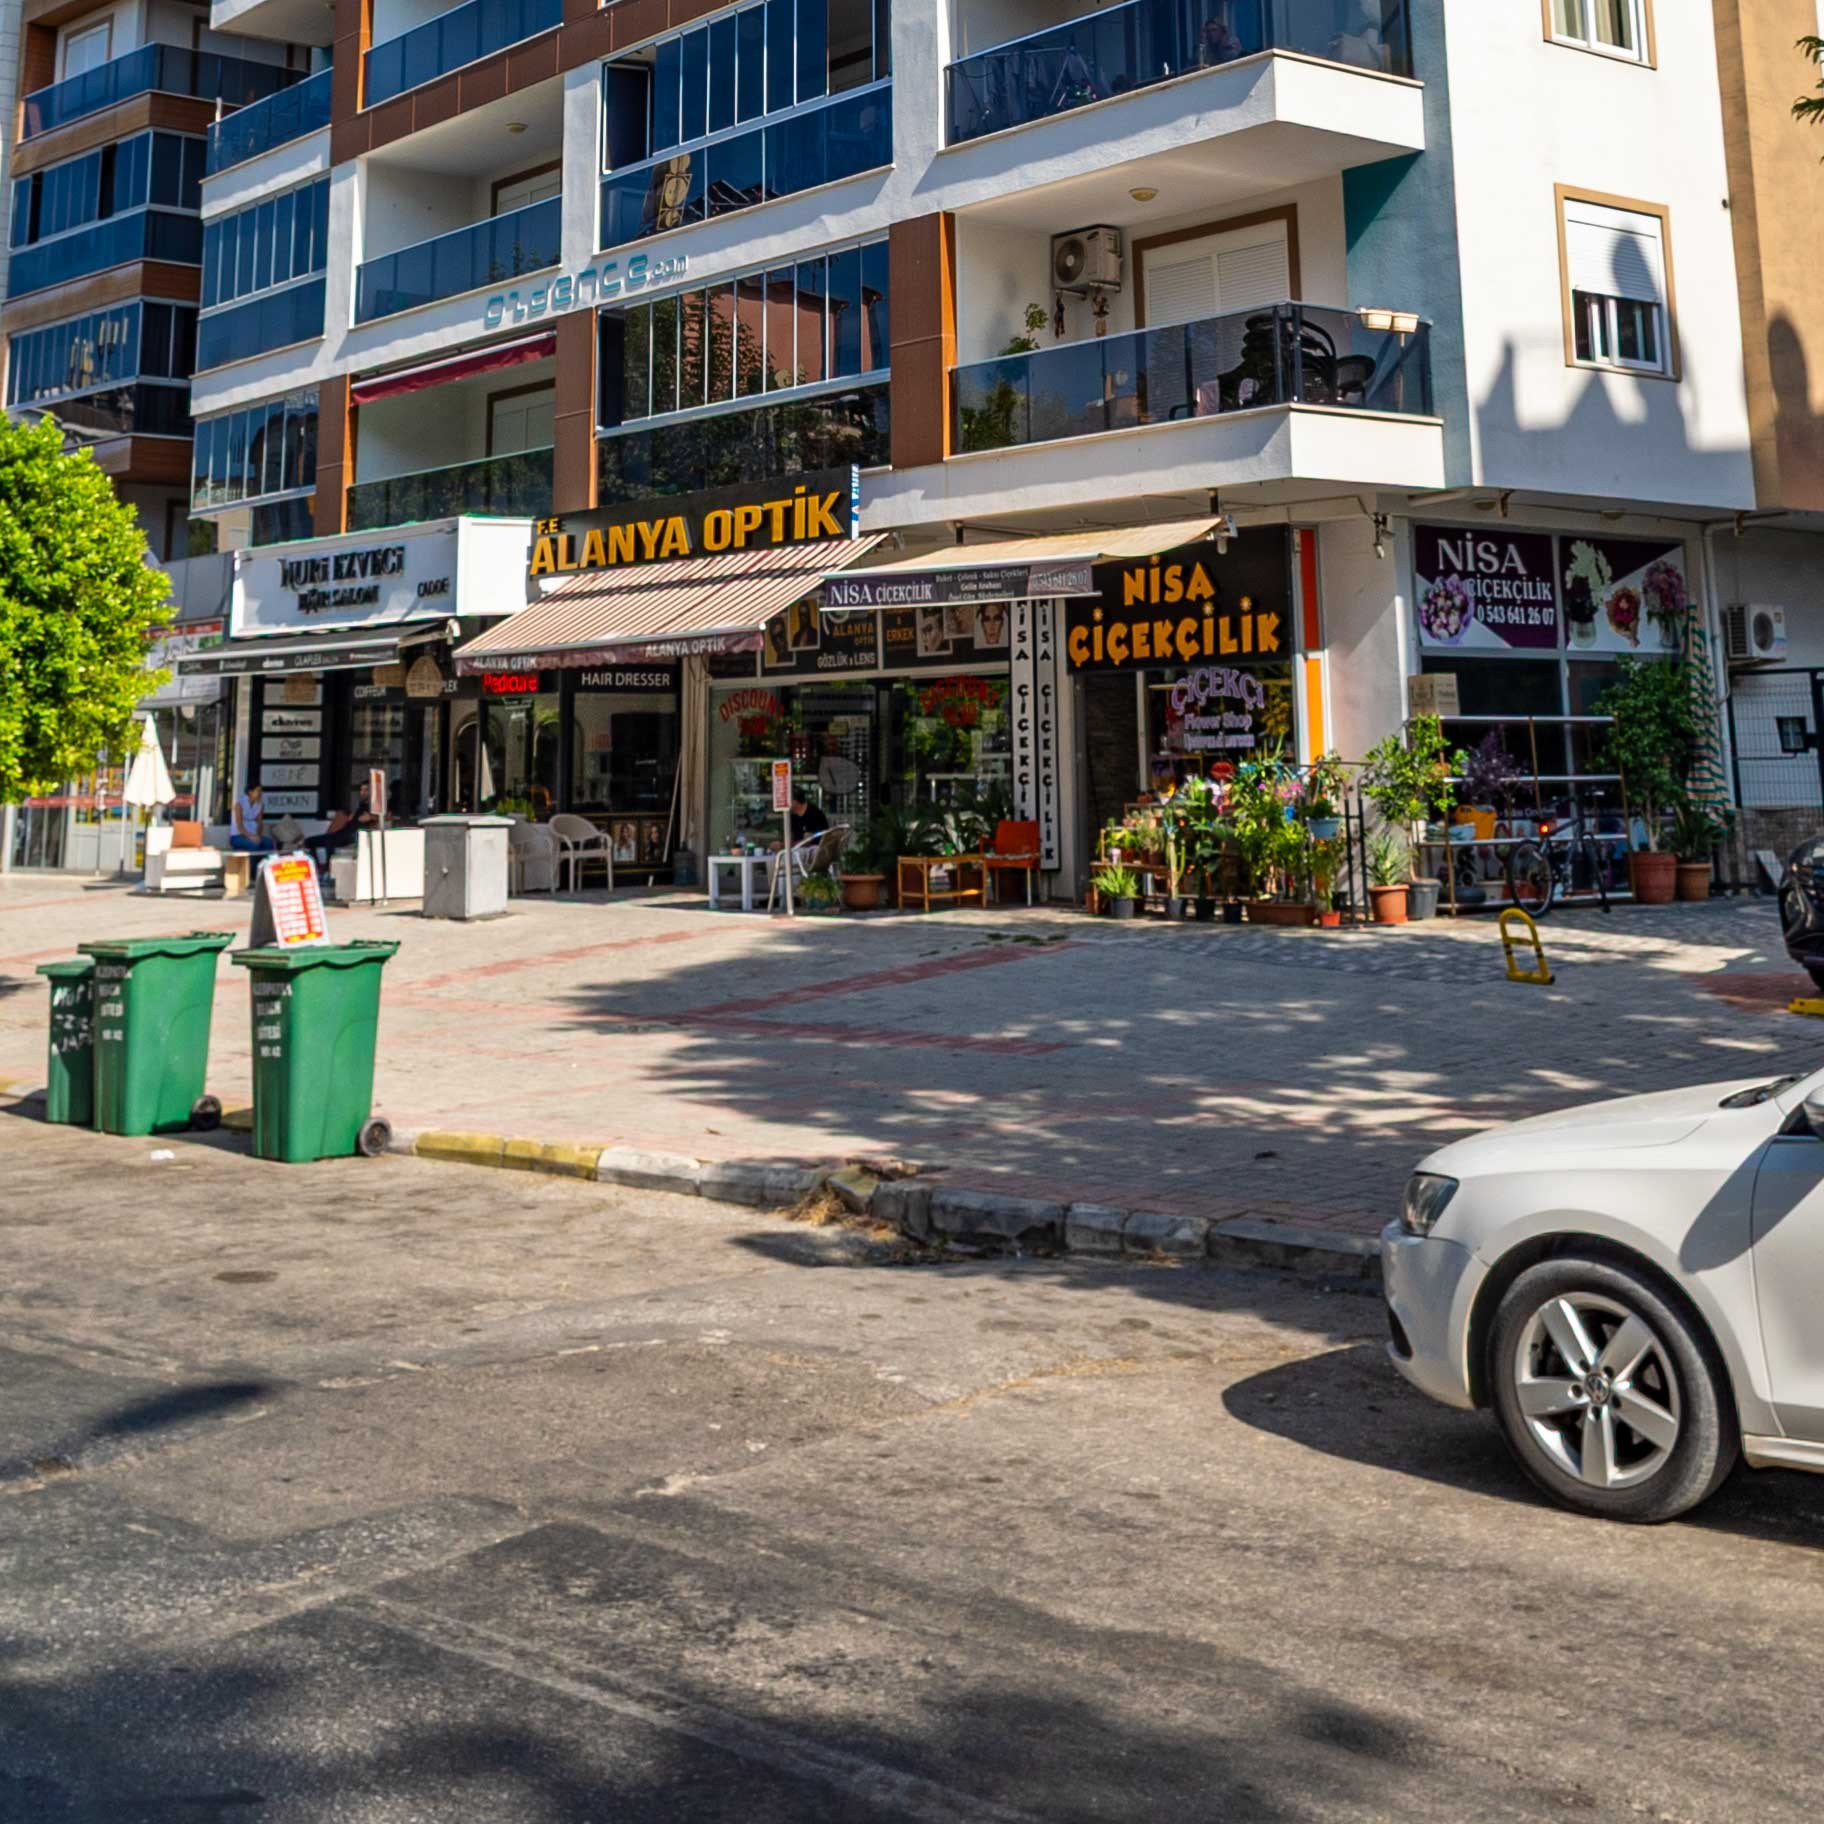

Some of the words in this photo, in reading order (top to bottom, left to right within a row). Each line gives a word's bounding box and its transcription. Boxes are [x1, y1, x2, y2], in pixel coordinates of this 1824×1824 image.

[530, 516, 691, 575] ALANYA
[703, 485, 844, 552] OPTİK
[1437, 531, 1528, 575] NİSA
[830, 579, 873, 605] NİSA
[875, 580, 933, 604] ÇİÇEKÇİLİK
[1123, 554, 1216, 606] NİSA
[1486, 605, 1506, 623] 543
[1507, 606, 1526, 624] 641
[1528, 607, 1541, 625] 26
[1542, 608, 1555, 625] 07
[1068, 595, 1281, 668] ÇİÇEKÇİLİK
[645, 640, 689, 658] ALANYA
[483, 673, 539, 694] Pedicure
[581, 672, 612, 686] HAIR
[615, 673, 671, 687] DRESSER
